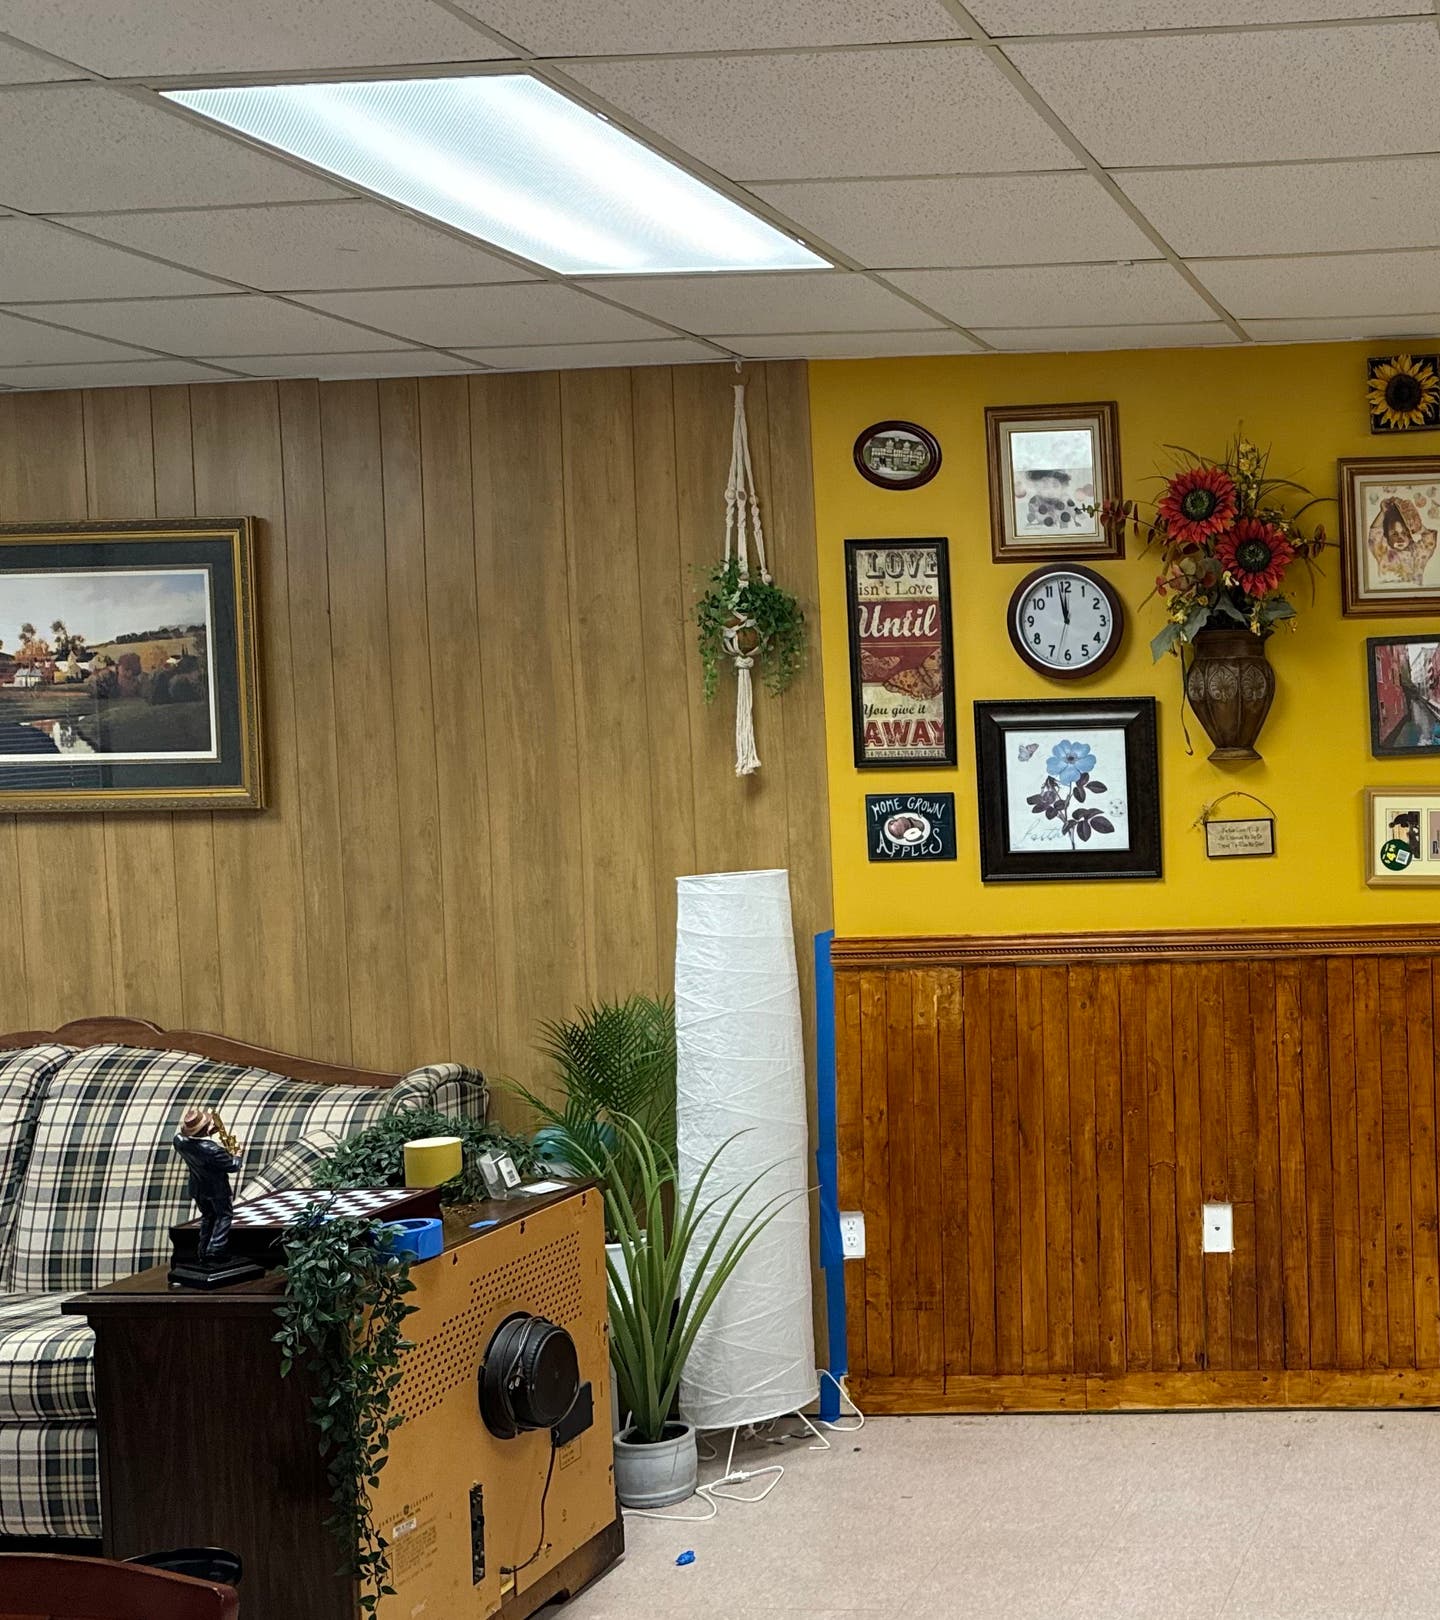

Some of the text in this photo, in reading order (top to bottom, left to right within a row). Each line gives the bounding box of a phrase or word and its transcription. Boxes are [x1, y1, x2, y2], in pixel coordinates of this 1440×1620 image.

[866, 550, 938, 579] LOVE
[859, 581, 933, 596] isn't Love
[1045, 586, 1053, 598] 11
[1060, 581, 1071, 593] 12
[1033, 598, 1045, 610] 10
[1092, 598, 1100, 610] 2
[859, 603, 938, 638] Until
[1027, 616, 1034, 627] 9
[1099, 615, 1107, 627] 3
[1033, 632, 1041, 645] 8
[1093, 632, 1101, 644] 4
[1048, 645, 1056, 657] 7
[1064, 649, 1072, 661] 6
[1081, 645, 1089, 656] 5
[864, 703, 927, 719] You give it
[864, 718, 944, 748] AWAY
[871, 796, 946, 821] HOME GROWN
[876, 828, 943, 857] APPLES
